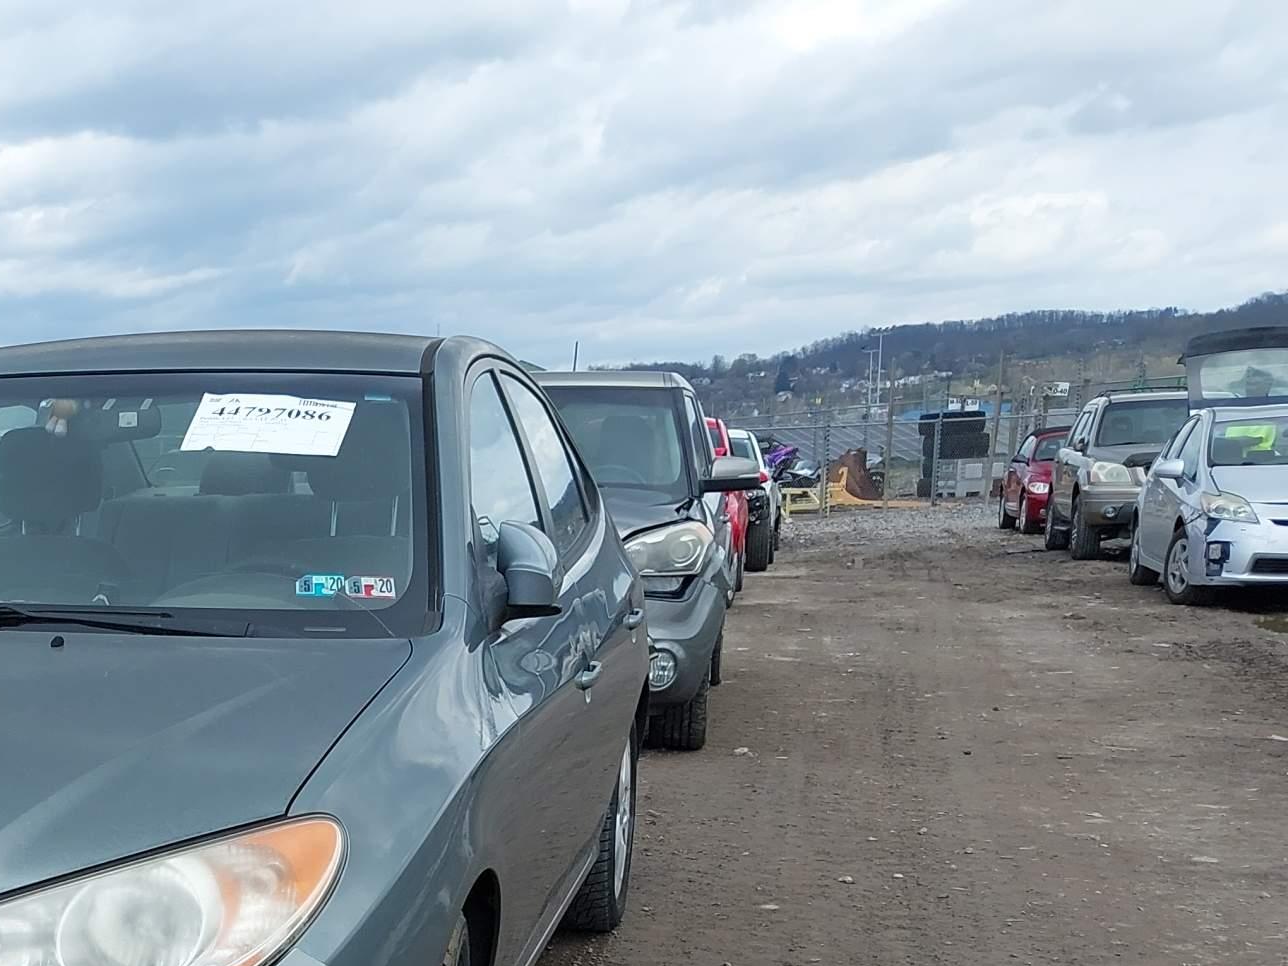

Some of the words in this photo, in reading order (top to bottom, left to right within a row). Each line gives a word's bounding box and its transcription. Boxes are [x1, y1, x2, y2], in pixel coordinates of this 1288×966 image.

[211, 405, 332, 422] 44797086
[329, 576, 343, 592] 20
[378, 578, 393, 593] 20
